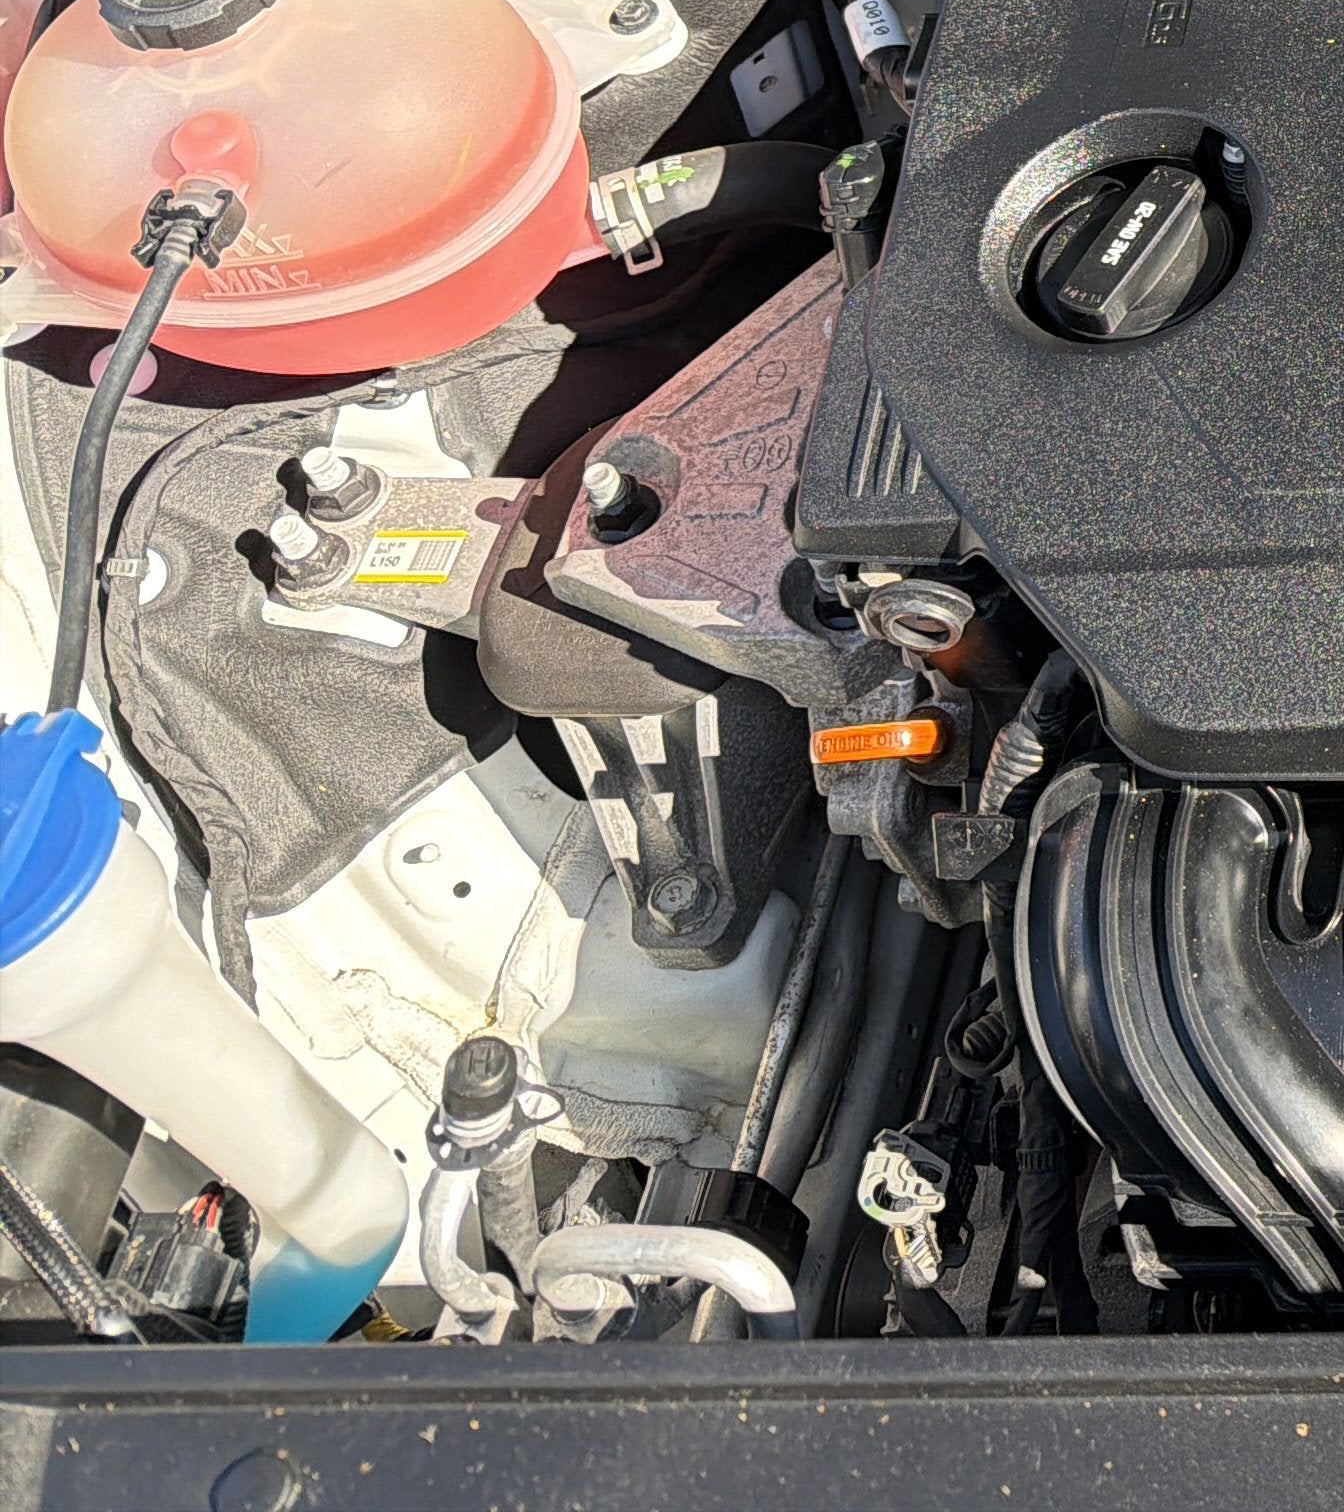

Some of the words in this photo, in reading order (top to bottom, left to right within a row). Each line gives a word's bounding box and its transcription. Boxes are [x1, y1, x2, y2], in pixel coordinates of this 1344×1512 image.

[1101, 238, 1131, 267] SAE
[1119, 201, 1157, 240] 0W-20
[203, 264, 287, 295] MIN
